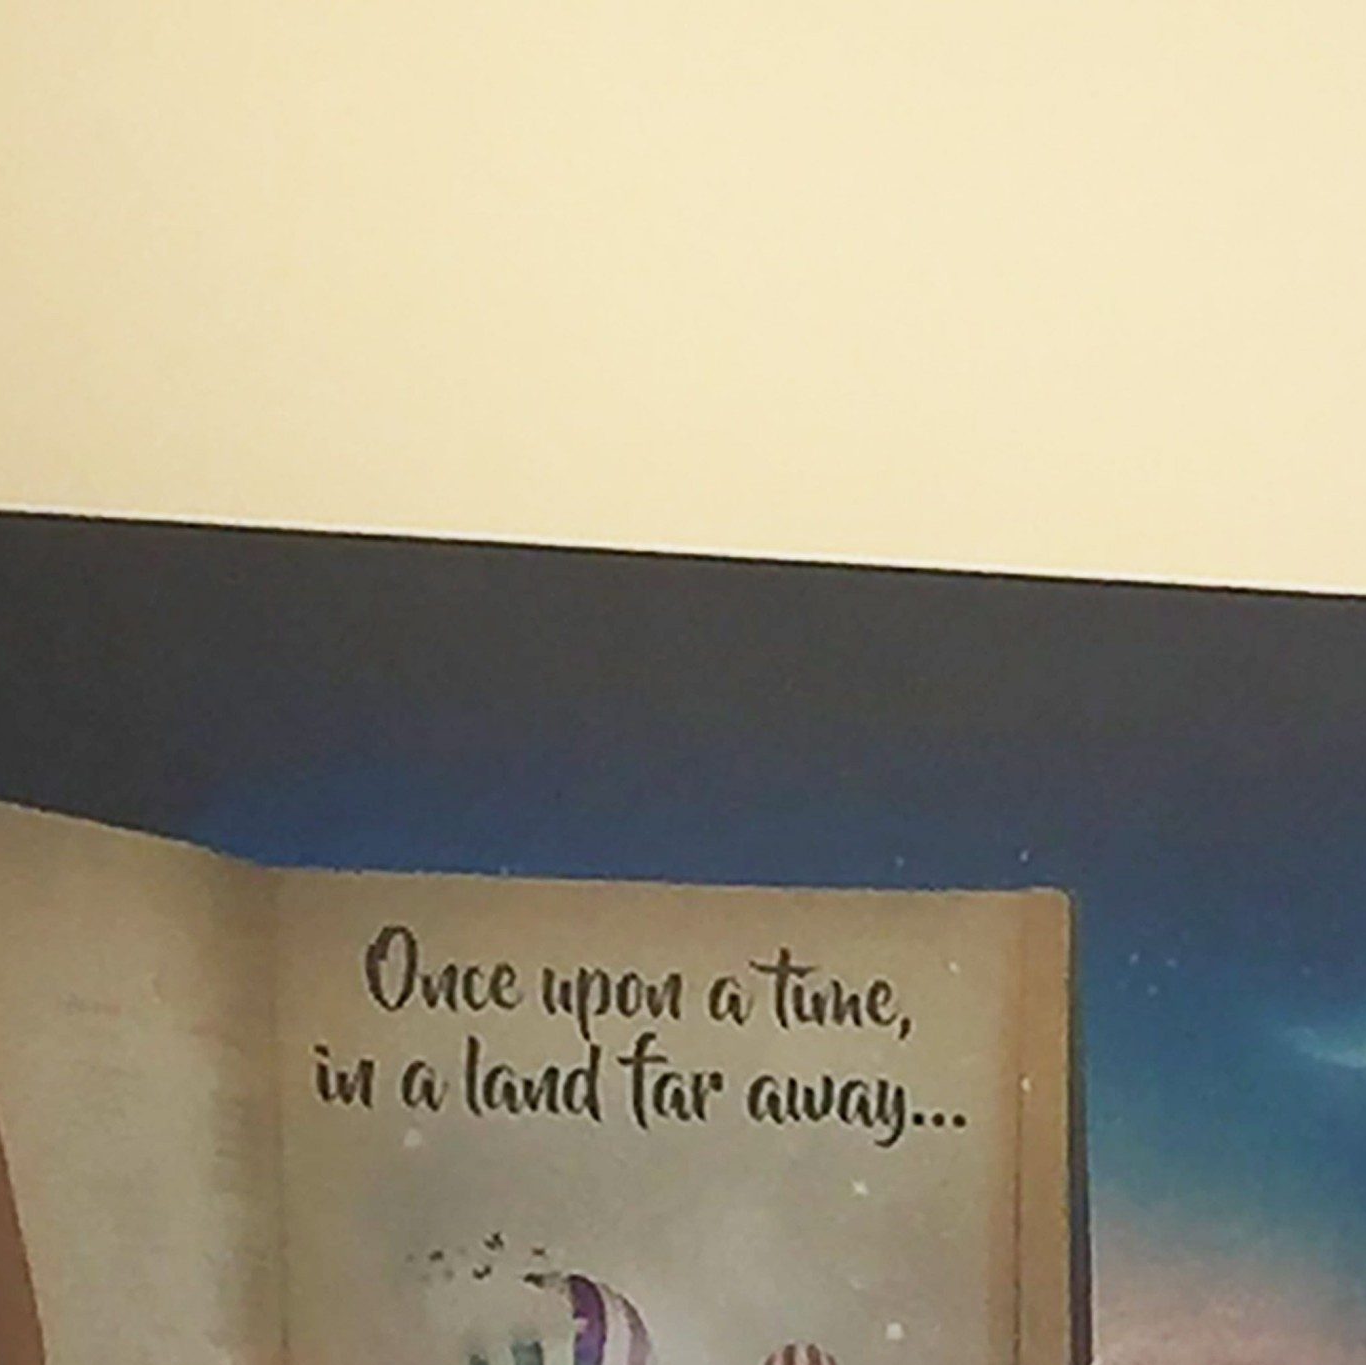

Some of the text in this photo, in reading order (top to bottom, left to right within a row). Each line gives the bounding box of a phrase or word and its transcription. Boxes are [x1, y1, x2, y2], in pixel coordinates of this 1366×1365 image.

[364, 924, 913, 1041] Once upon a time,
[313, 1032, 968, 1147] in a land far away...
